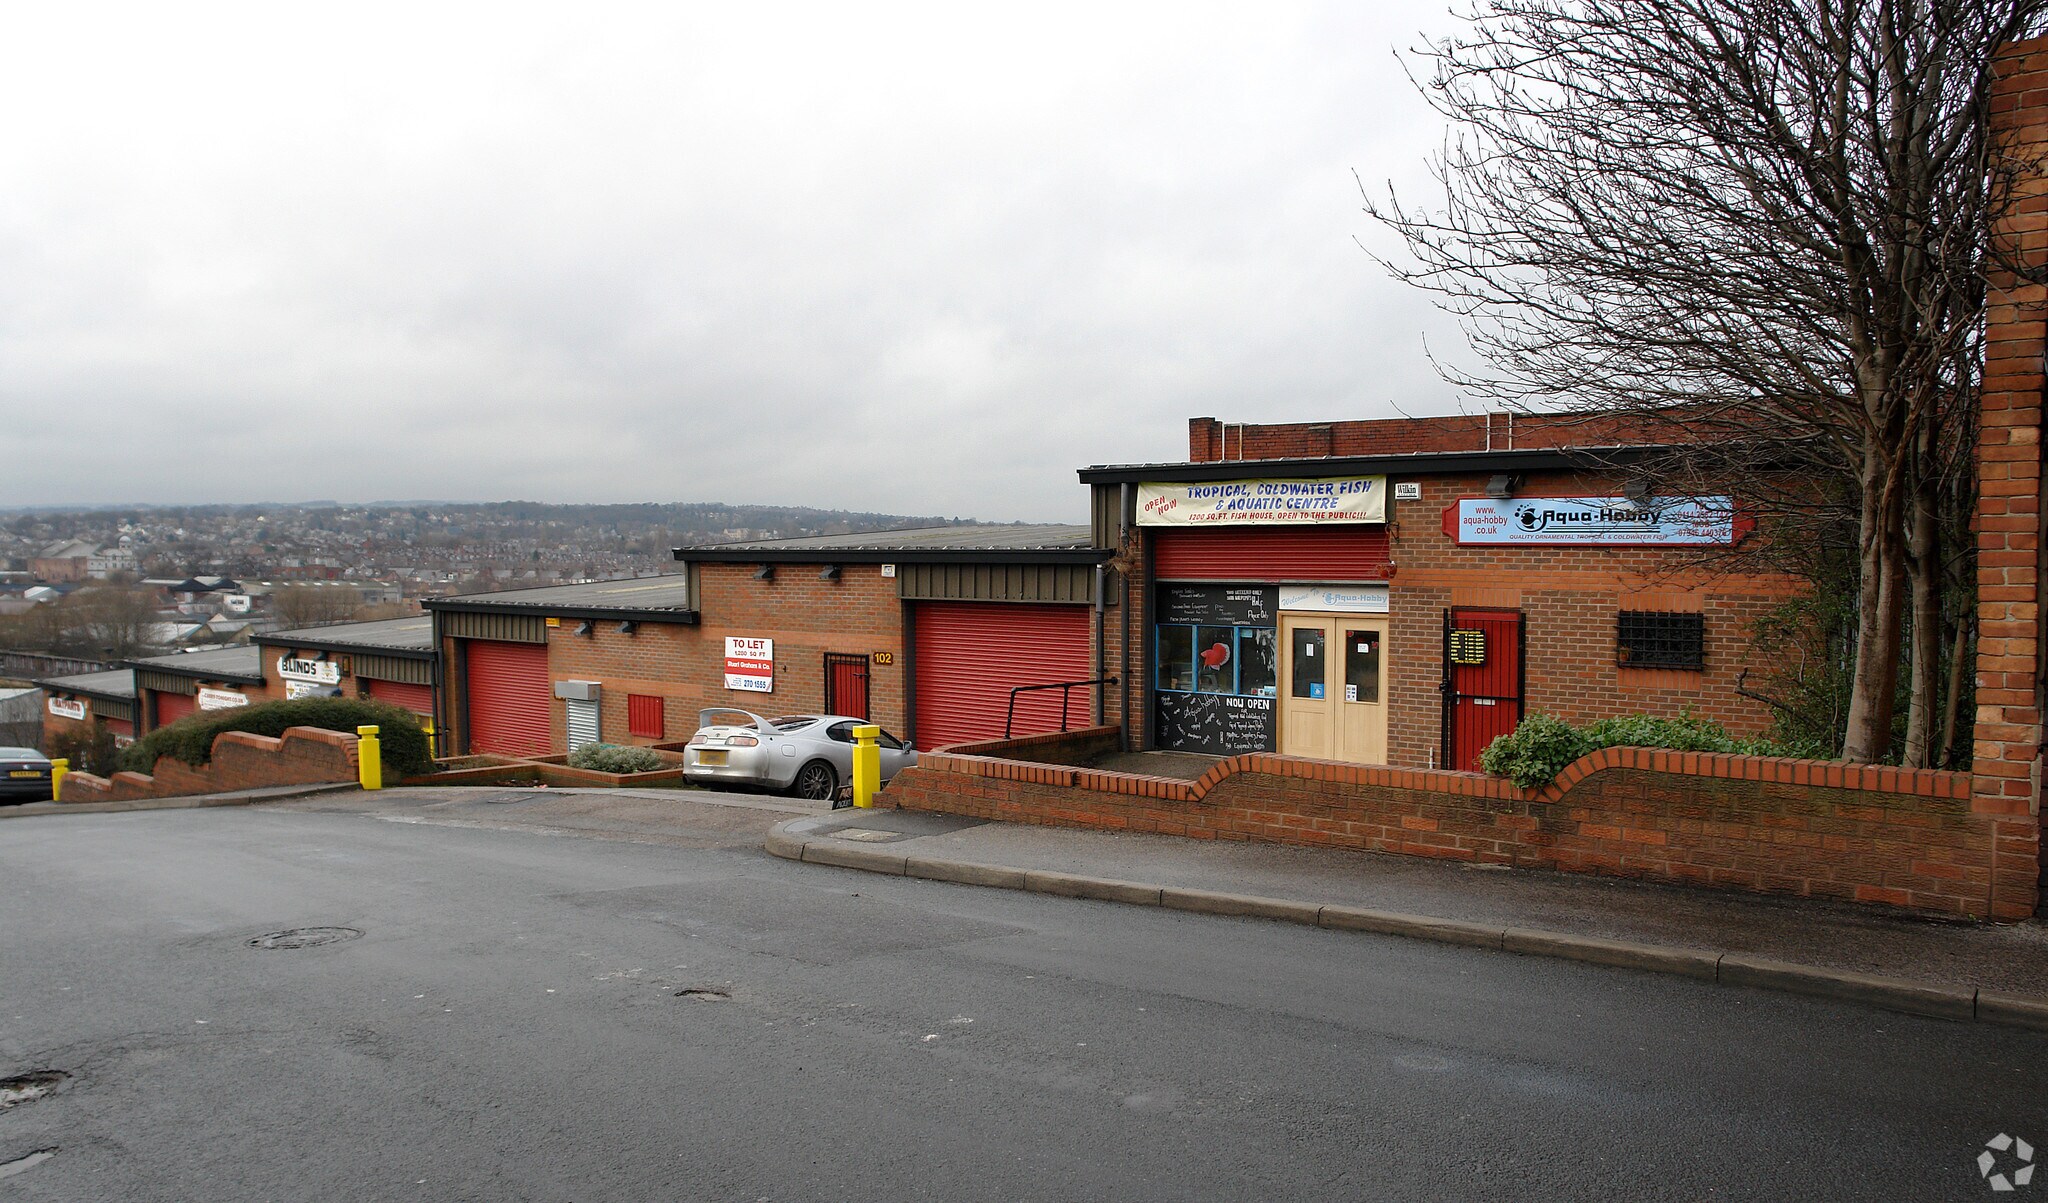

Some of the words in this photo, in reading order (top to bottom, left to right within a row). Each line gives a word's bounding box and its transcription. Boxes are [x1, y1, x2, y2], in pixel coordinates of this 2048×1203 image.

[1187, 484, 1251, 499] TROPICAL,
[1257, 483, 1334, 496] COLDWATER
[1339, 481, 1372, 494] FISH
[1144, 495, 1166, 512] OPEN
[1157, 498, 1177, 516] NOW
[1215, 500, 1225, 510] &
[1227, 497, 1281, 511] AQUATIC
[1286, 497, 1339, 510] CENTRE
[1189, 513, 1205, 521] 1200
[1230, 512, 1248, 520] FISH
[1250, 512, 1276, 520] HOUSE,
[1277, 512, 1298, 520] OPEN
[1300, 512, 1308, 520] TO
[1311, 511, 1326, 520] THE
[1328, 511, 1367, 520] PUBLIC!!!
[1475, 507, 1496, 515] www.
[1463, 515, 1508, 527] aqua-hobby
[1474, 526, 1497, 535] .co.uk
[1332, 594, 1387, 603] Aqua-Hobby
[733, 639, 745, 649] TO
[747, 640, 765, 650] LET
[874, 653, 891, 663] 102
[282, 659, 317, 676] BLINDS
[744, 679, 753, 688] 270
[754, 681, 766, 689] 1555
[1226, 697, 1244, 708] NOW
[1248, 698, 1270, 711] OPEN
